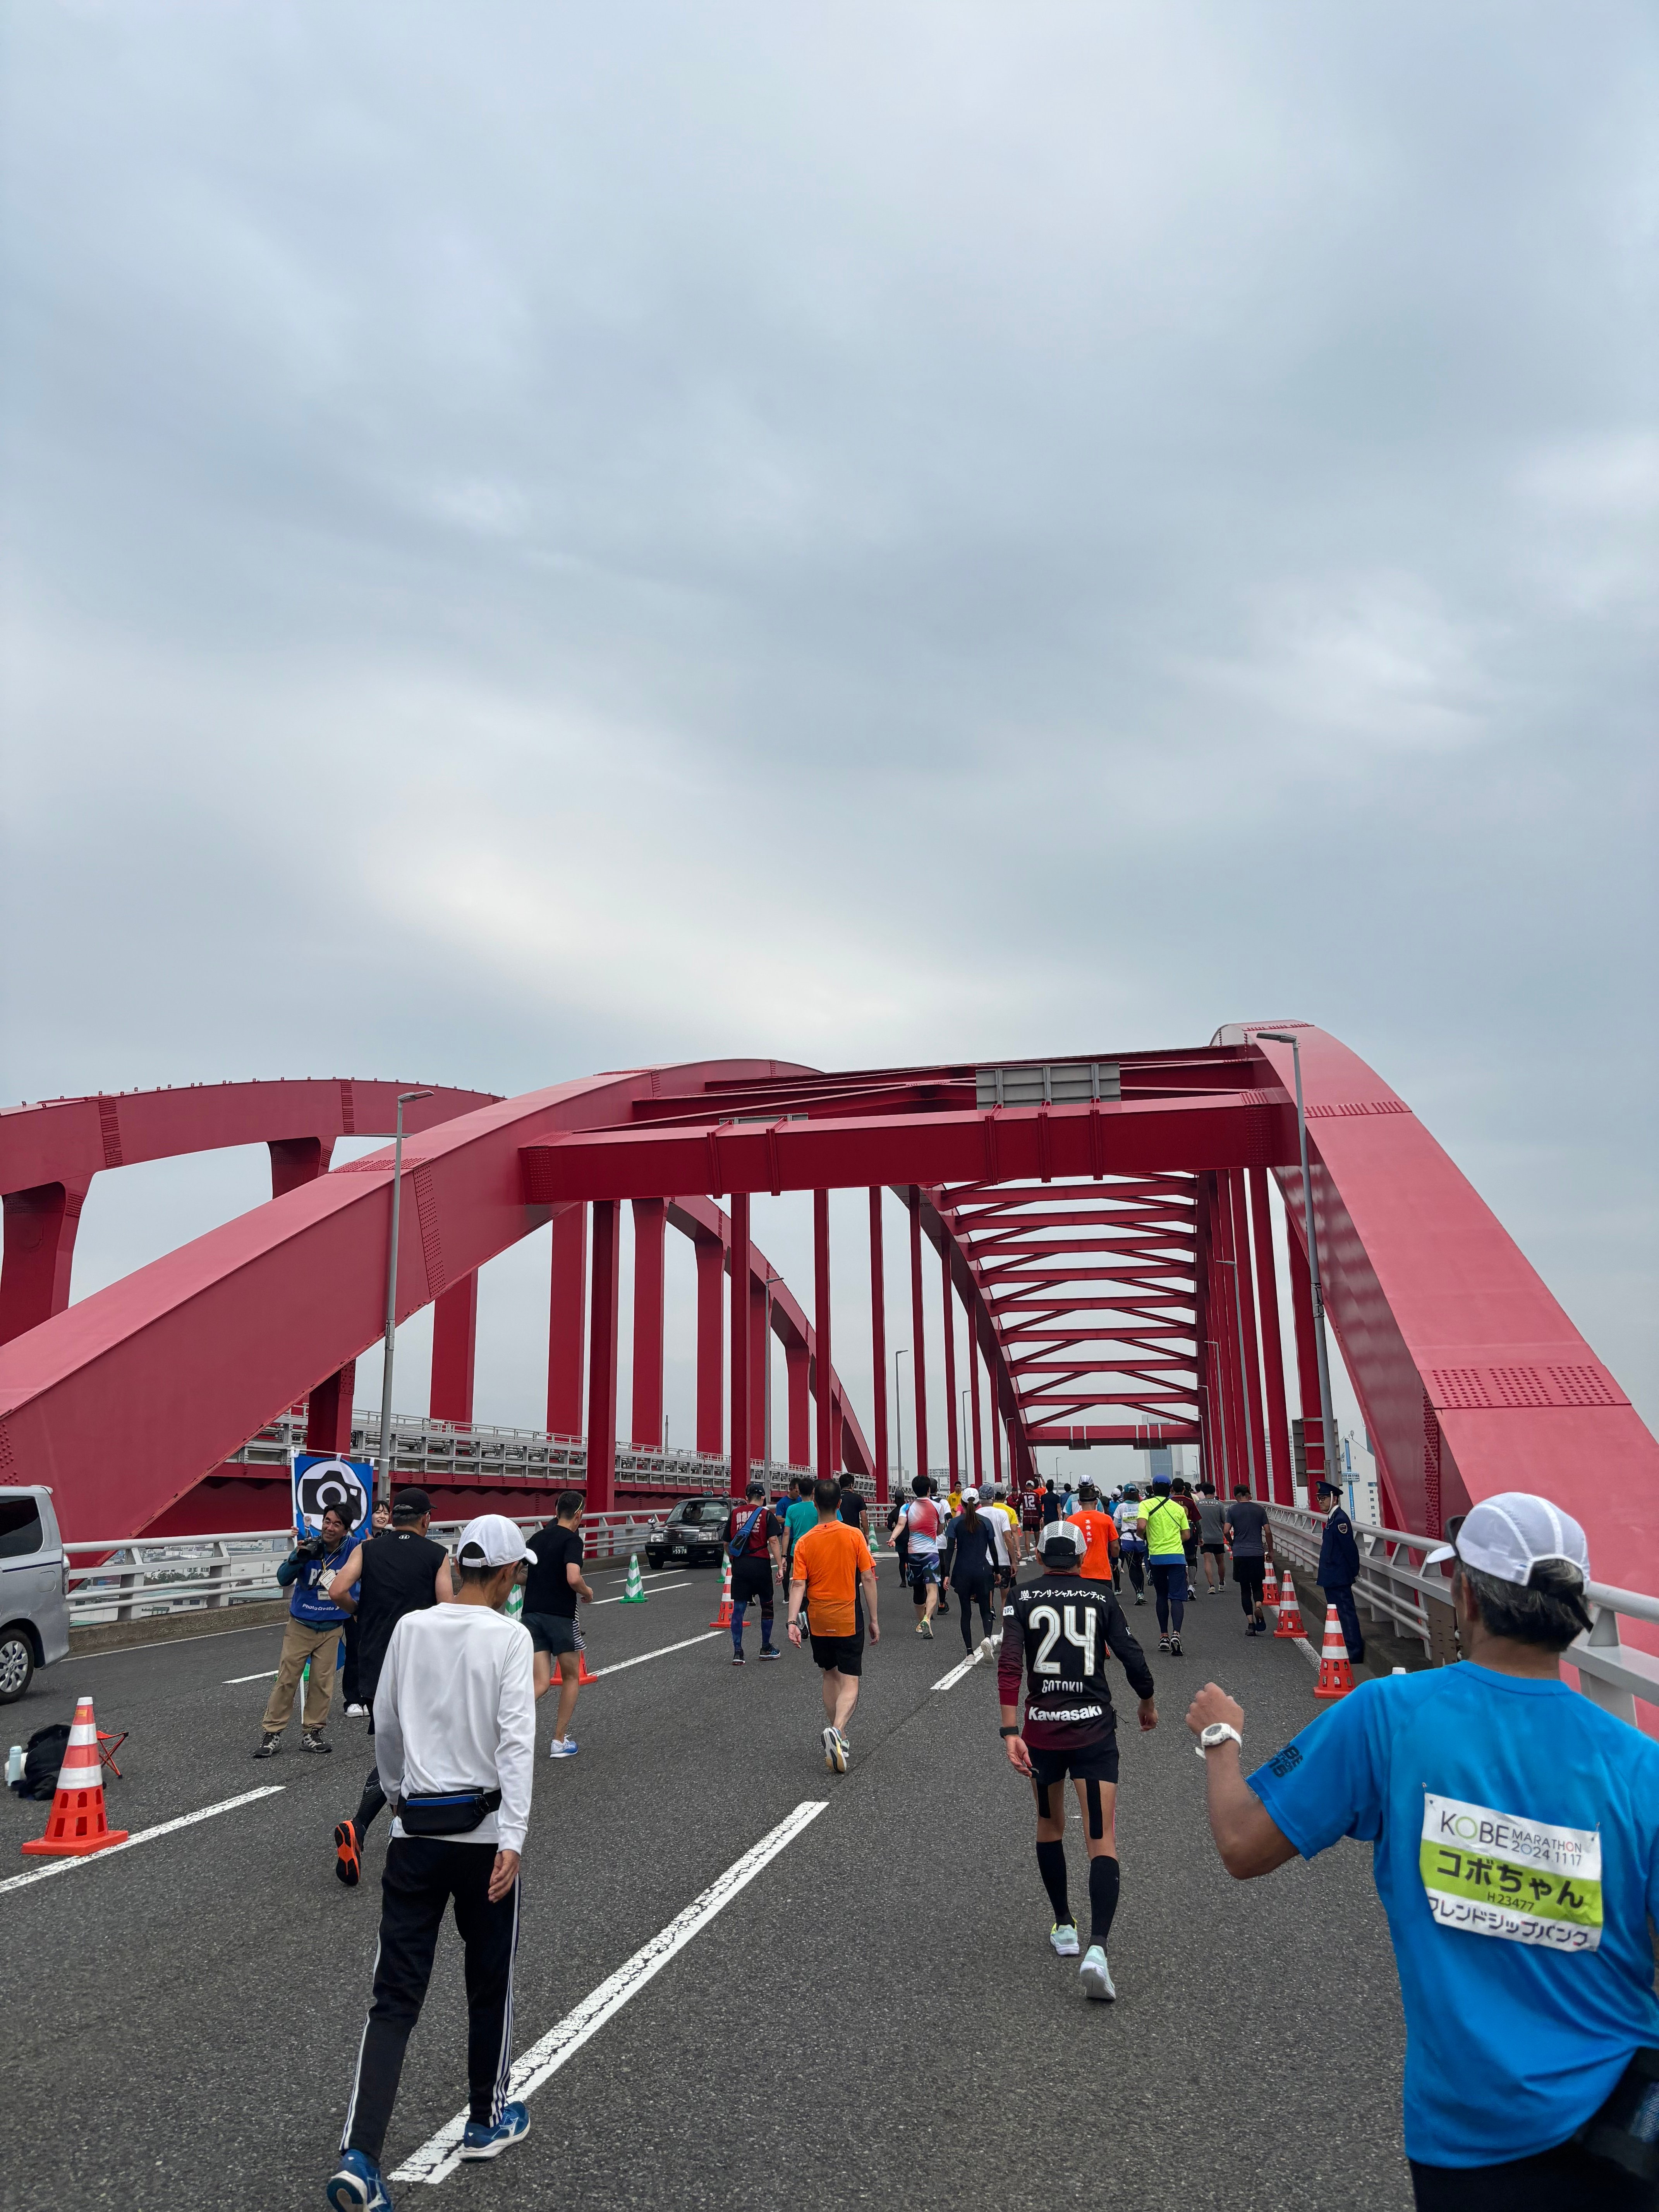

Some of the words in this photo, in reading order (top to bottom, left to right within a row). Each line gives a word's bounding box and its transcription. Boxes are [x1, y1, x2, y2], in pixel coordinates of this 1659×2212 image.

[1024, 1495, 1035, 1507] 12
[1032, 1589, 1106, 1602] アンリ・シャルパンティエ
[1029, 1605, 1097, 1676] 24
[1042, 1679, 1083, 1693] GOTOKU
[1028, 1705, 1103, 1721] Kawasaki
[1440, 1810, 1510, 1849] KOBE
[1512, 1829, 1582, 1853] MARATHON
[1437, 1850, 1583, 1909] コボちゃん
[1487, 1891, 1534, 1912] H23477
[1428, 1896, 1588, 1947] フレンドシップバンク
